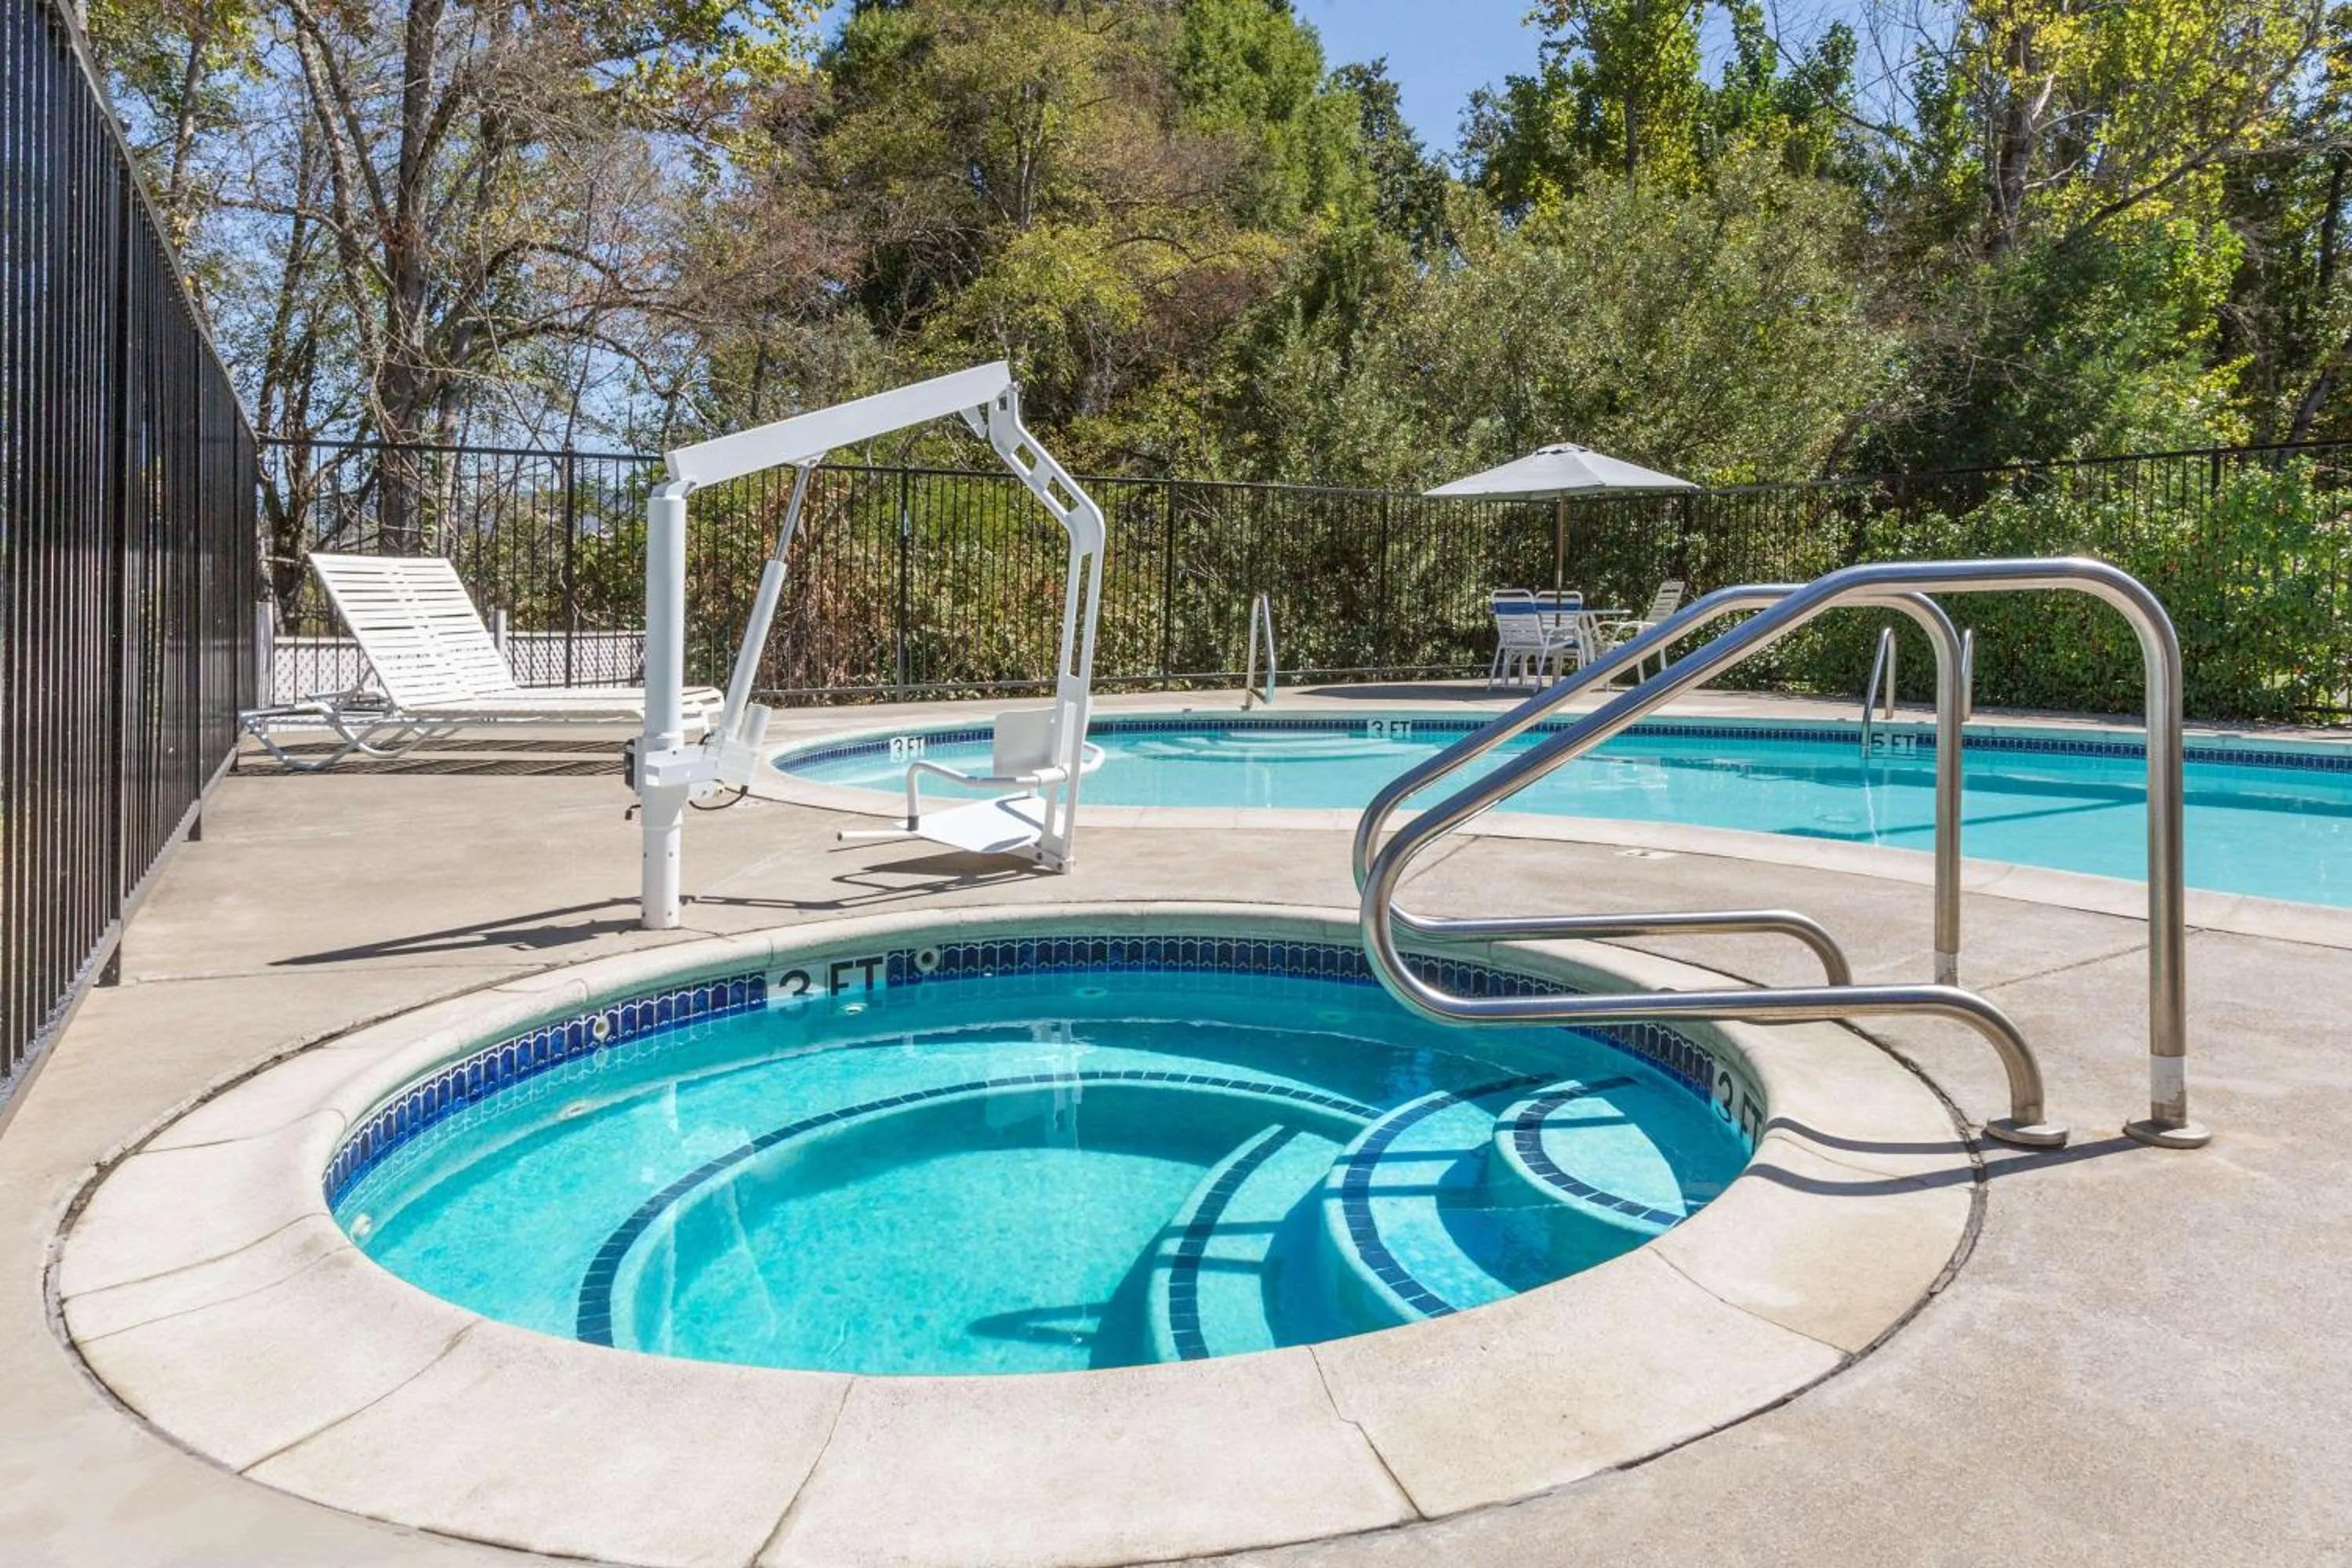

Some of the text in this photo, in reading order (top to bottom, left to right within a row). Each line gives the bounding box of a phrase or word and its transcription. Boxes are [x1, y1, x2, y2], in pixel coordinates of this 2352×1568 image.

[1390, 720, 1410, 739] FT
[907, 737, 923, 750] FT
[1871, 733, 1915, 754] 5 FT
[830, 955, 884, 1000] FT
[1716, 1071, 1764, 1158] 3 FT
